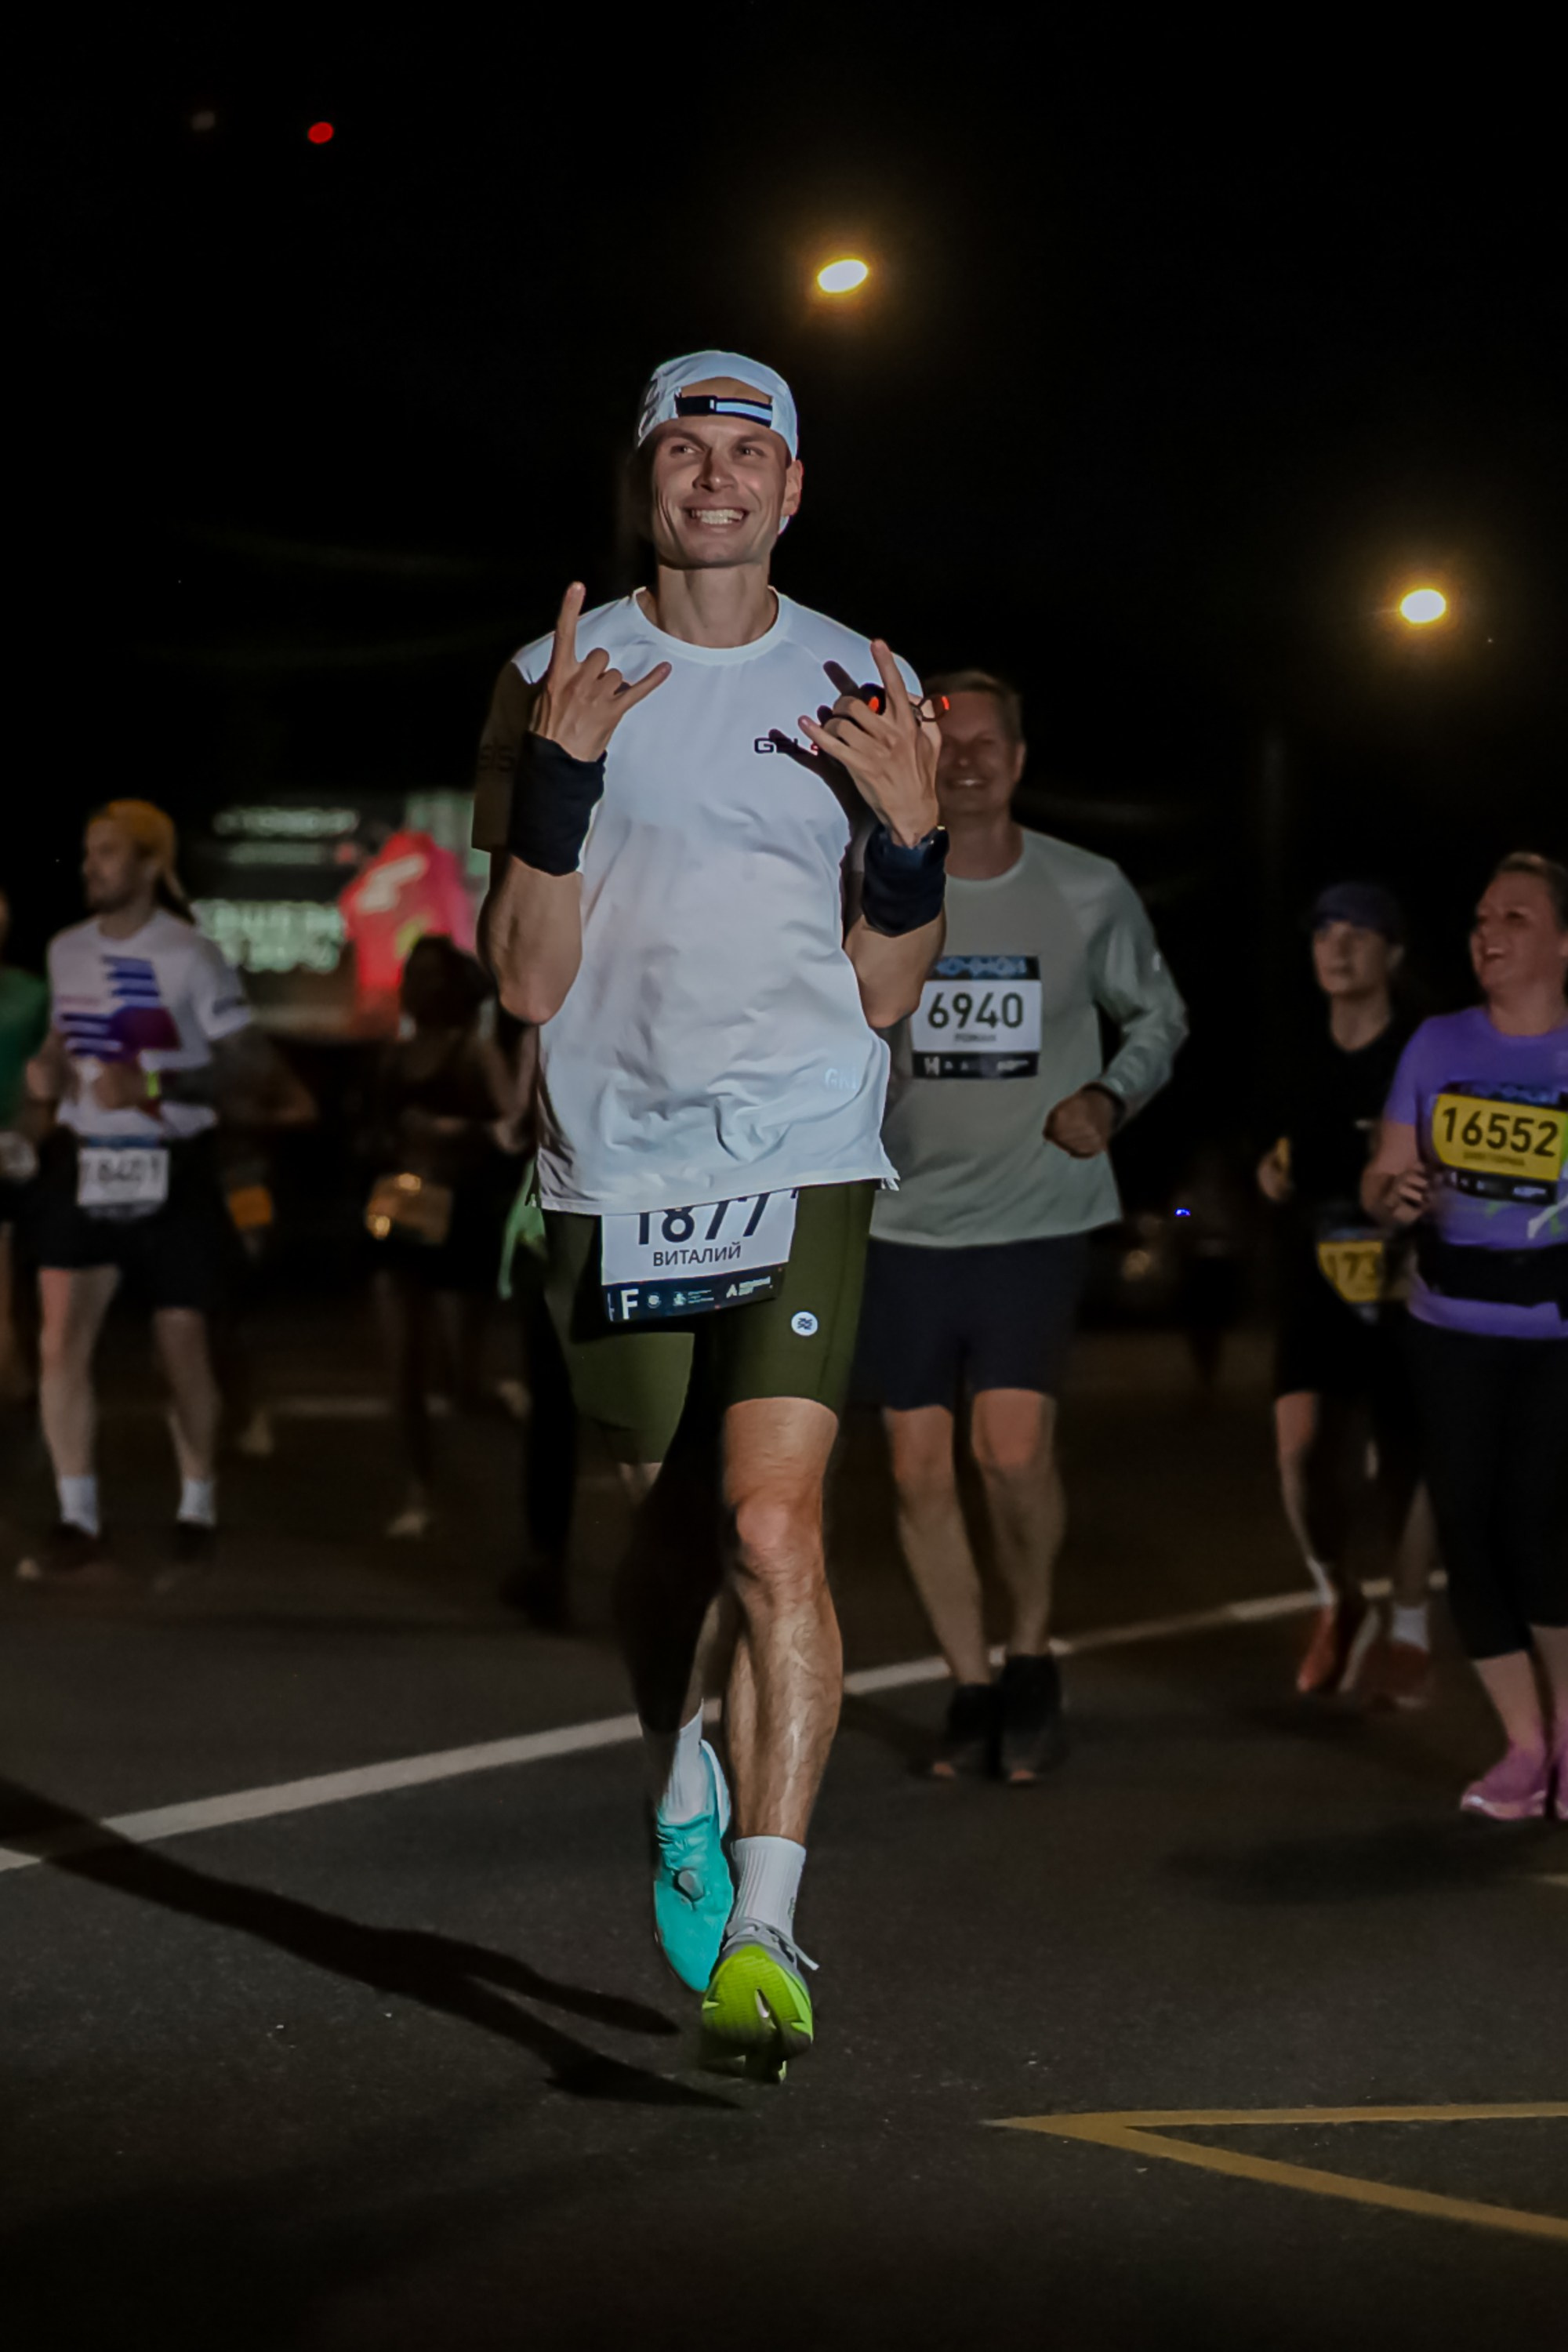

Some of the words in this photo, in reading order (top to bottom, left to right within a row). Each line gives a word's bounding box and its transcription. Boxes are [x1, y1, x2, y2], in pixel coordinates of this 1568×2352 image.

[927, 992, 1023, 1029] 6940
[1442, 1107, 1558, 1157] 16552
[638, 1192, 770, 1245] 1877
[652, 1241, 742, 1267] ВИТАЛИЙ
[620, 1288, 639, 1320] F
